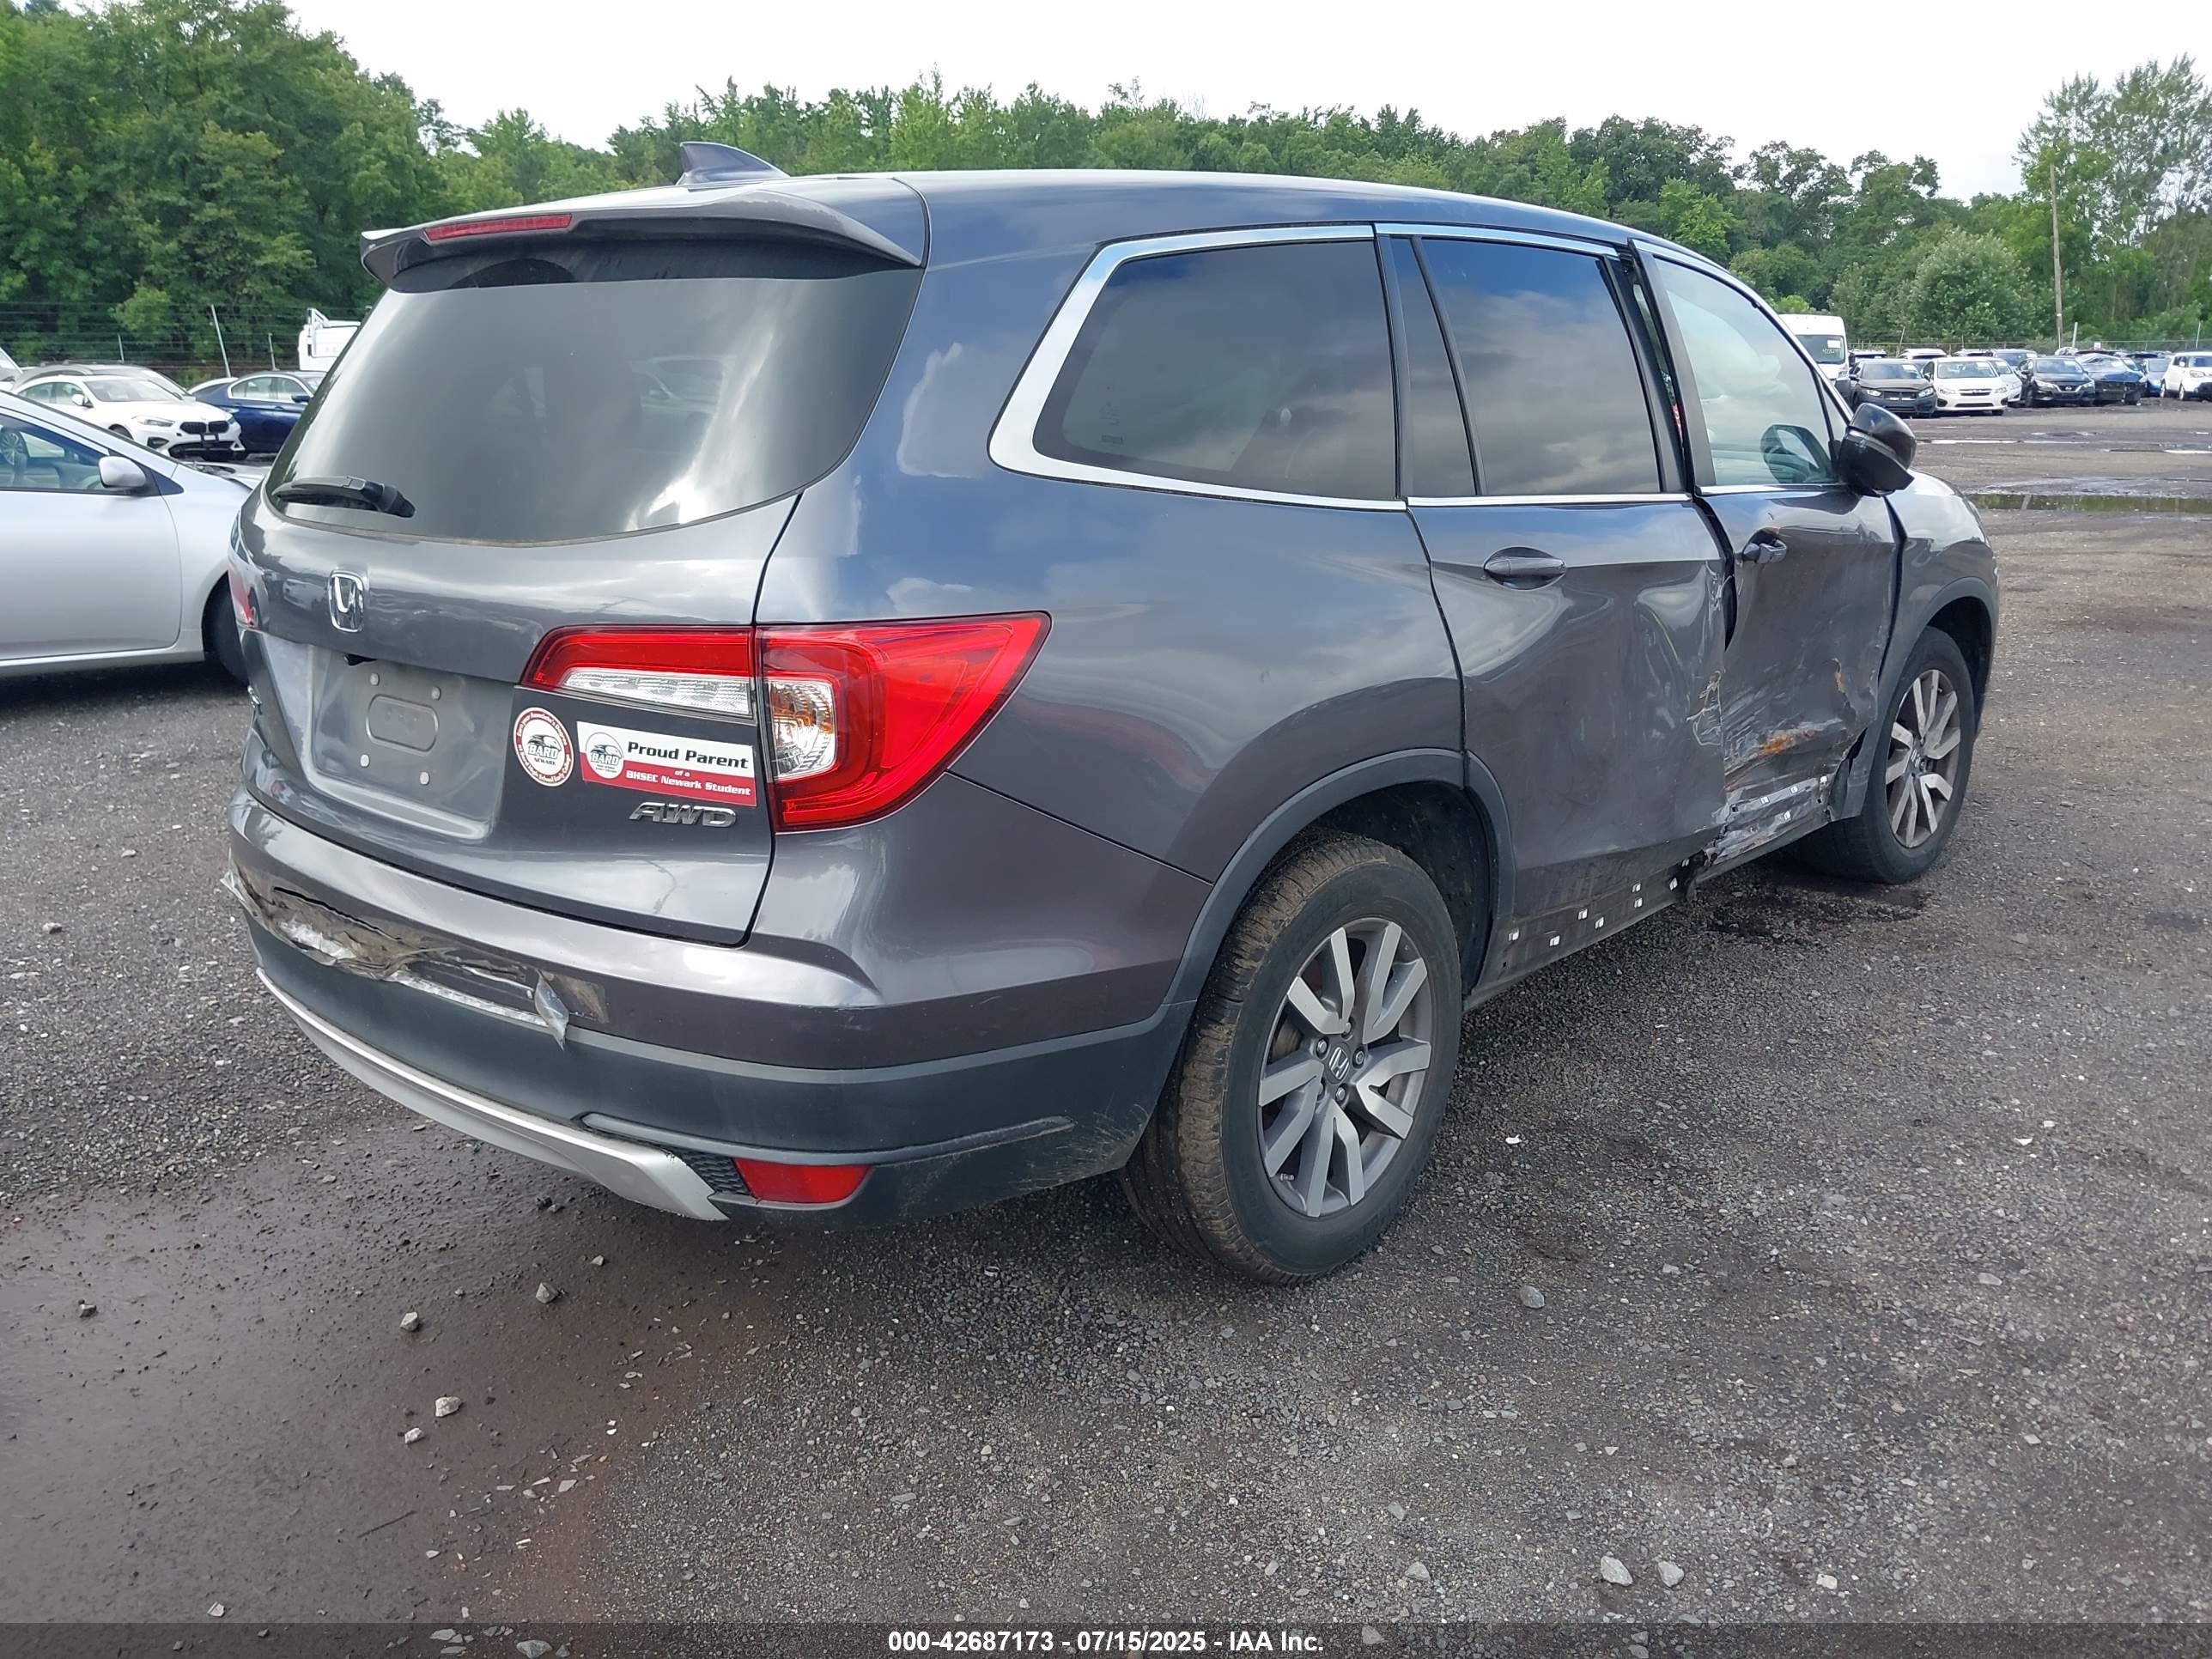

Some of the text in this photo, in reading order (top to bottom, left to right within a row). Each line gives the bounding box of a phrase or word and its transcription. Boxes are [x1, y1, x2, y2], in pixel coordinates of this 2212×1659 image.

[528, 744, 558, 759] BARD
[534, 757, 556, 766] NEWARK
[591, 752, 619, 766] BARD
[628, 741, 749, 769] Proud Parent
[626, 769, 751, 796] BHSEC Newark Student
[629, 802, 736, 828] AWD
